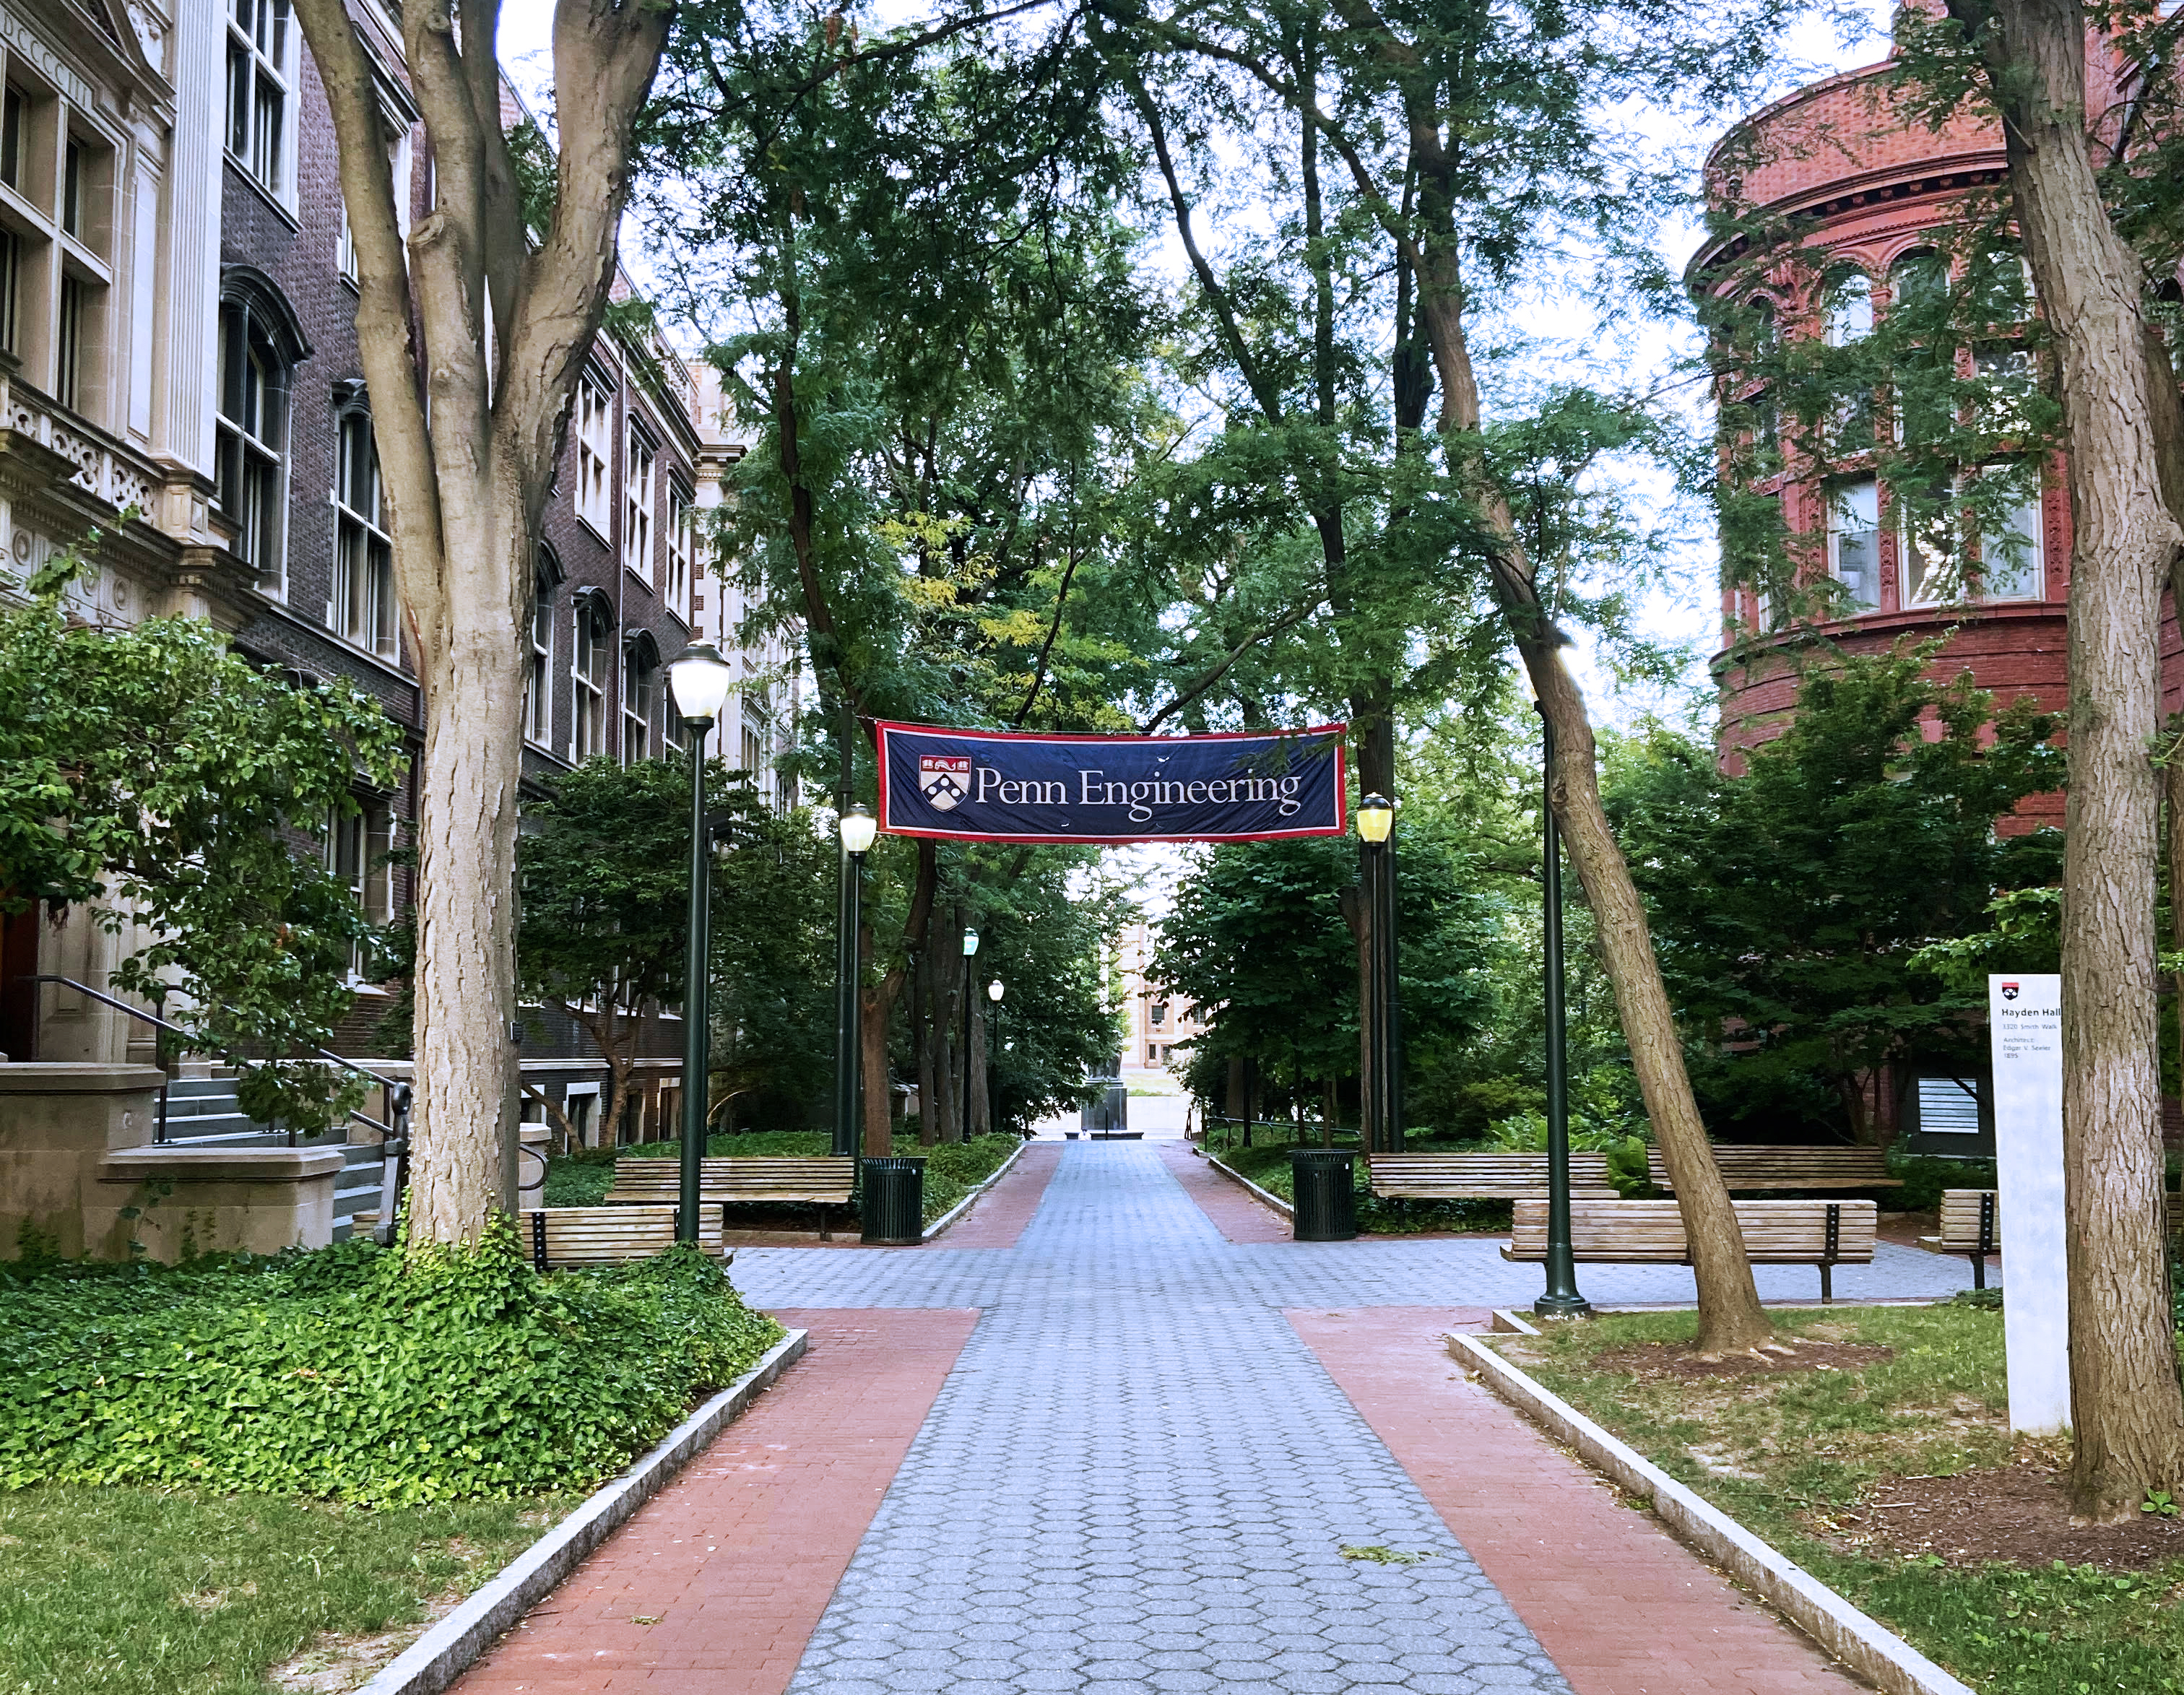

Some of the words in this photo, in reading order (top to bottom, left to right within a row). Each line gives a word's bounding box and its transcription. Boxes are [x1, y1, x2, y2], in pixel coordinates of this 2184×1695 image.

[975, 767, 1069, 805] Penn
[1078, 768, 1301, 823] Engineering
[2002, 1008, 2040, 1018] Hayden
